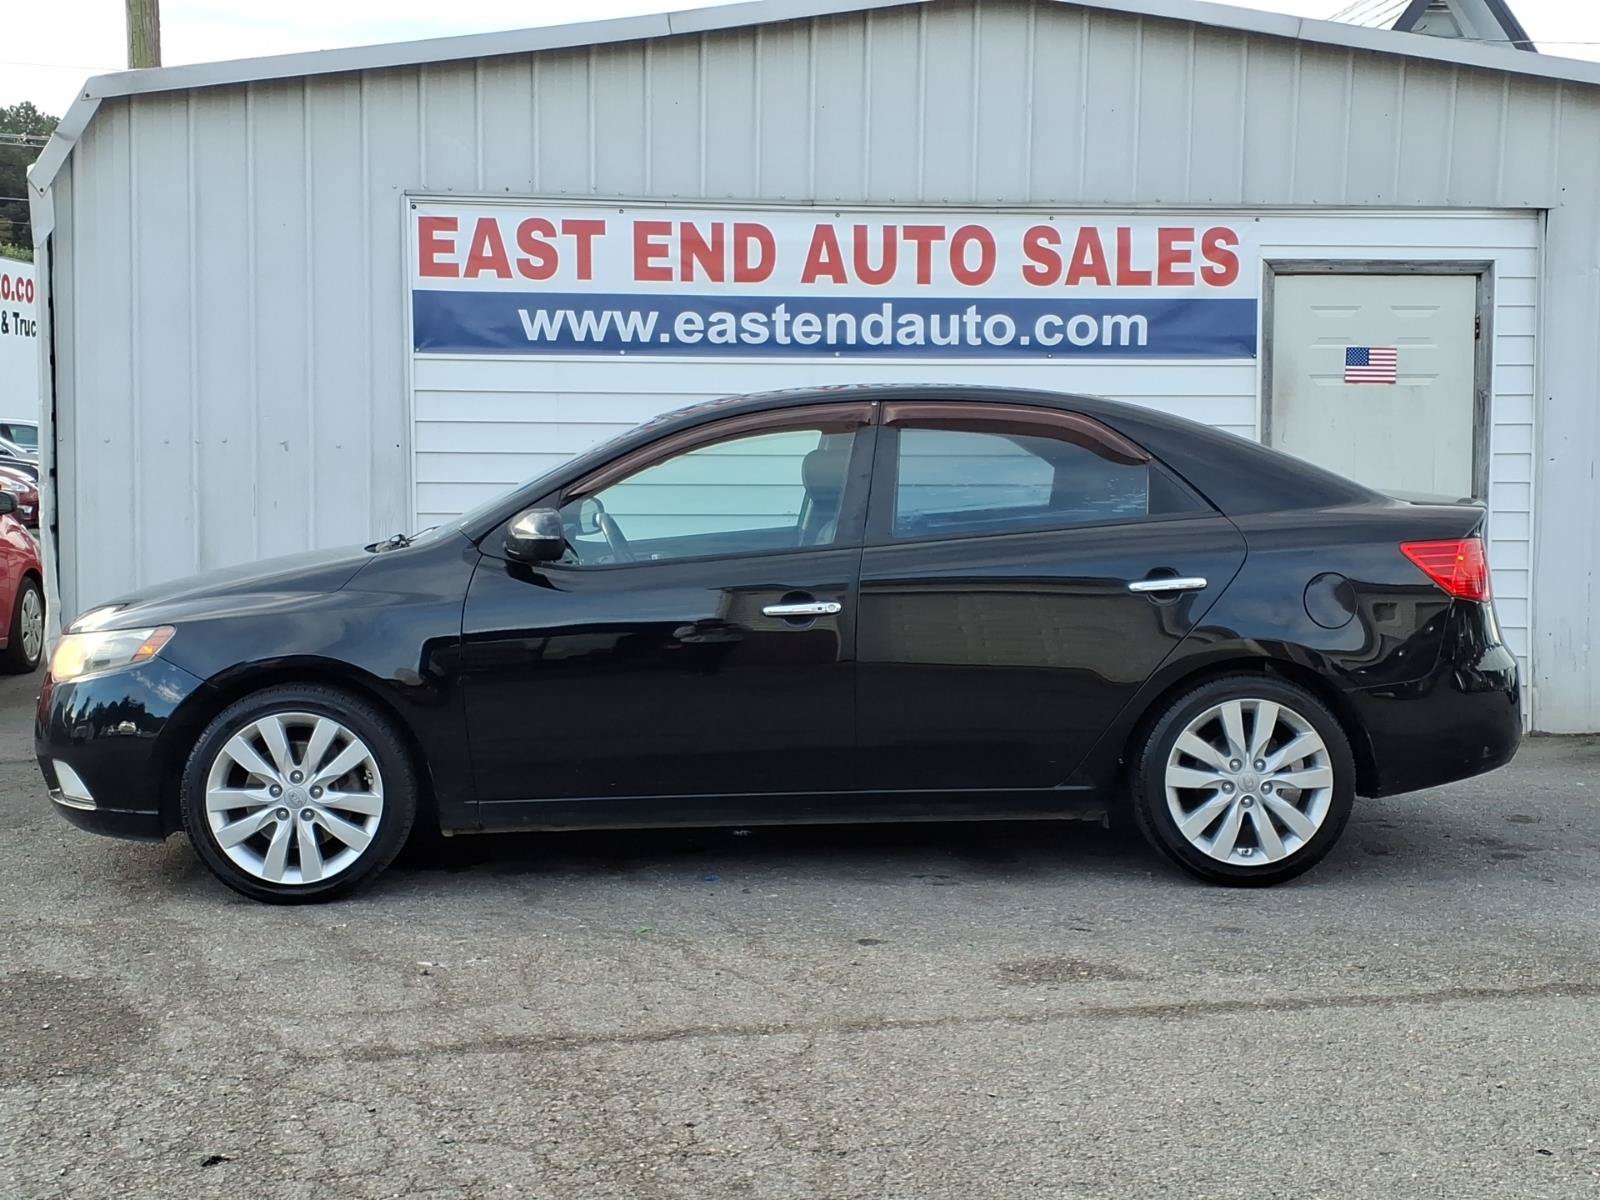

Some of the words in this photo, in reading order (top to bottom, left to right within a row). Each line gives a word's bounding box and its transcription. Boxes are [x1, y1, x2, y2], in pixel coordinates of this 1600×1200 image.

[418, 215, 606, 281] EAST
[633, 220, 777, 284] END
[801, 223, 997, 287] AUTO
[1021, 225, 1240, 288] SALES
[0, 273, 34, 304] O.CO
[1, 310, 9, 334] &
[12, 312, 37, 338] Truc
[518, 302, 1148, 347] www.eastendauto.com
